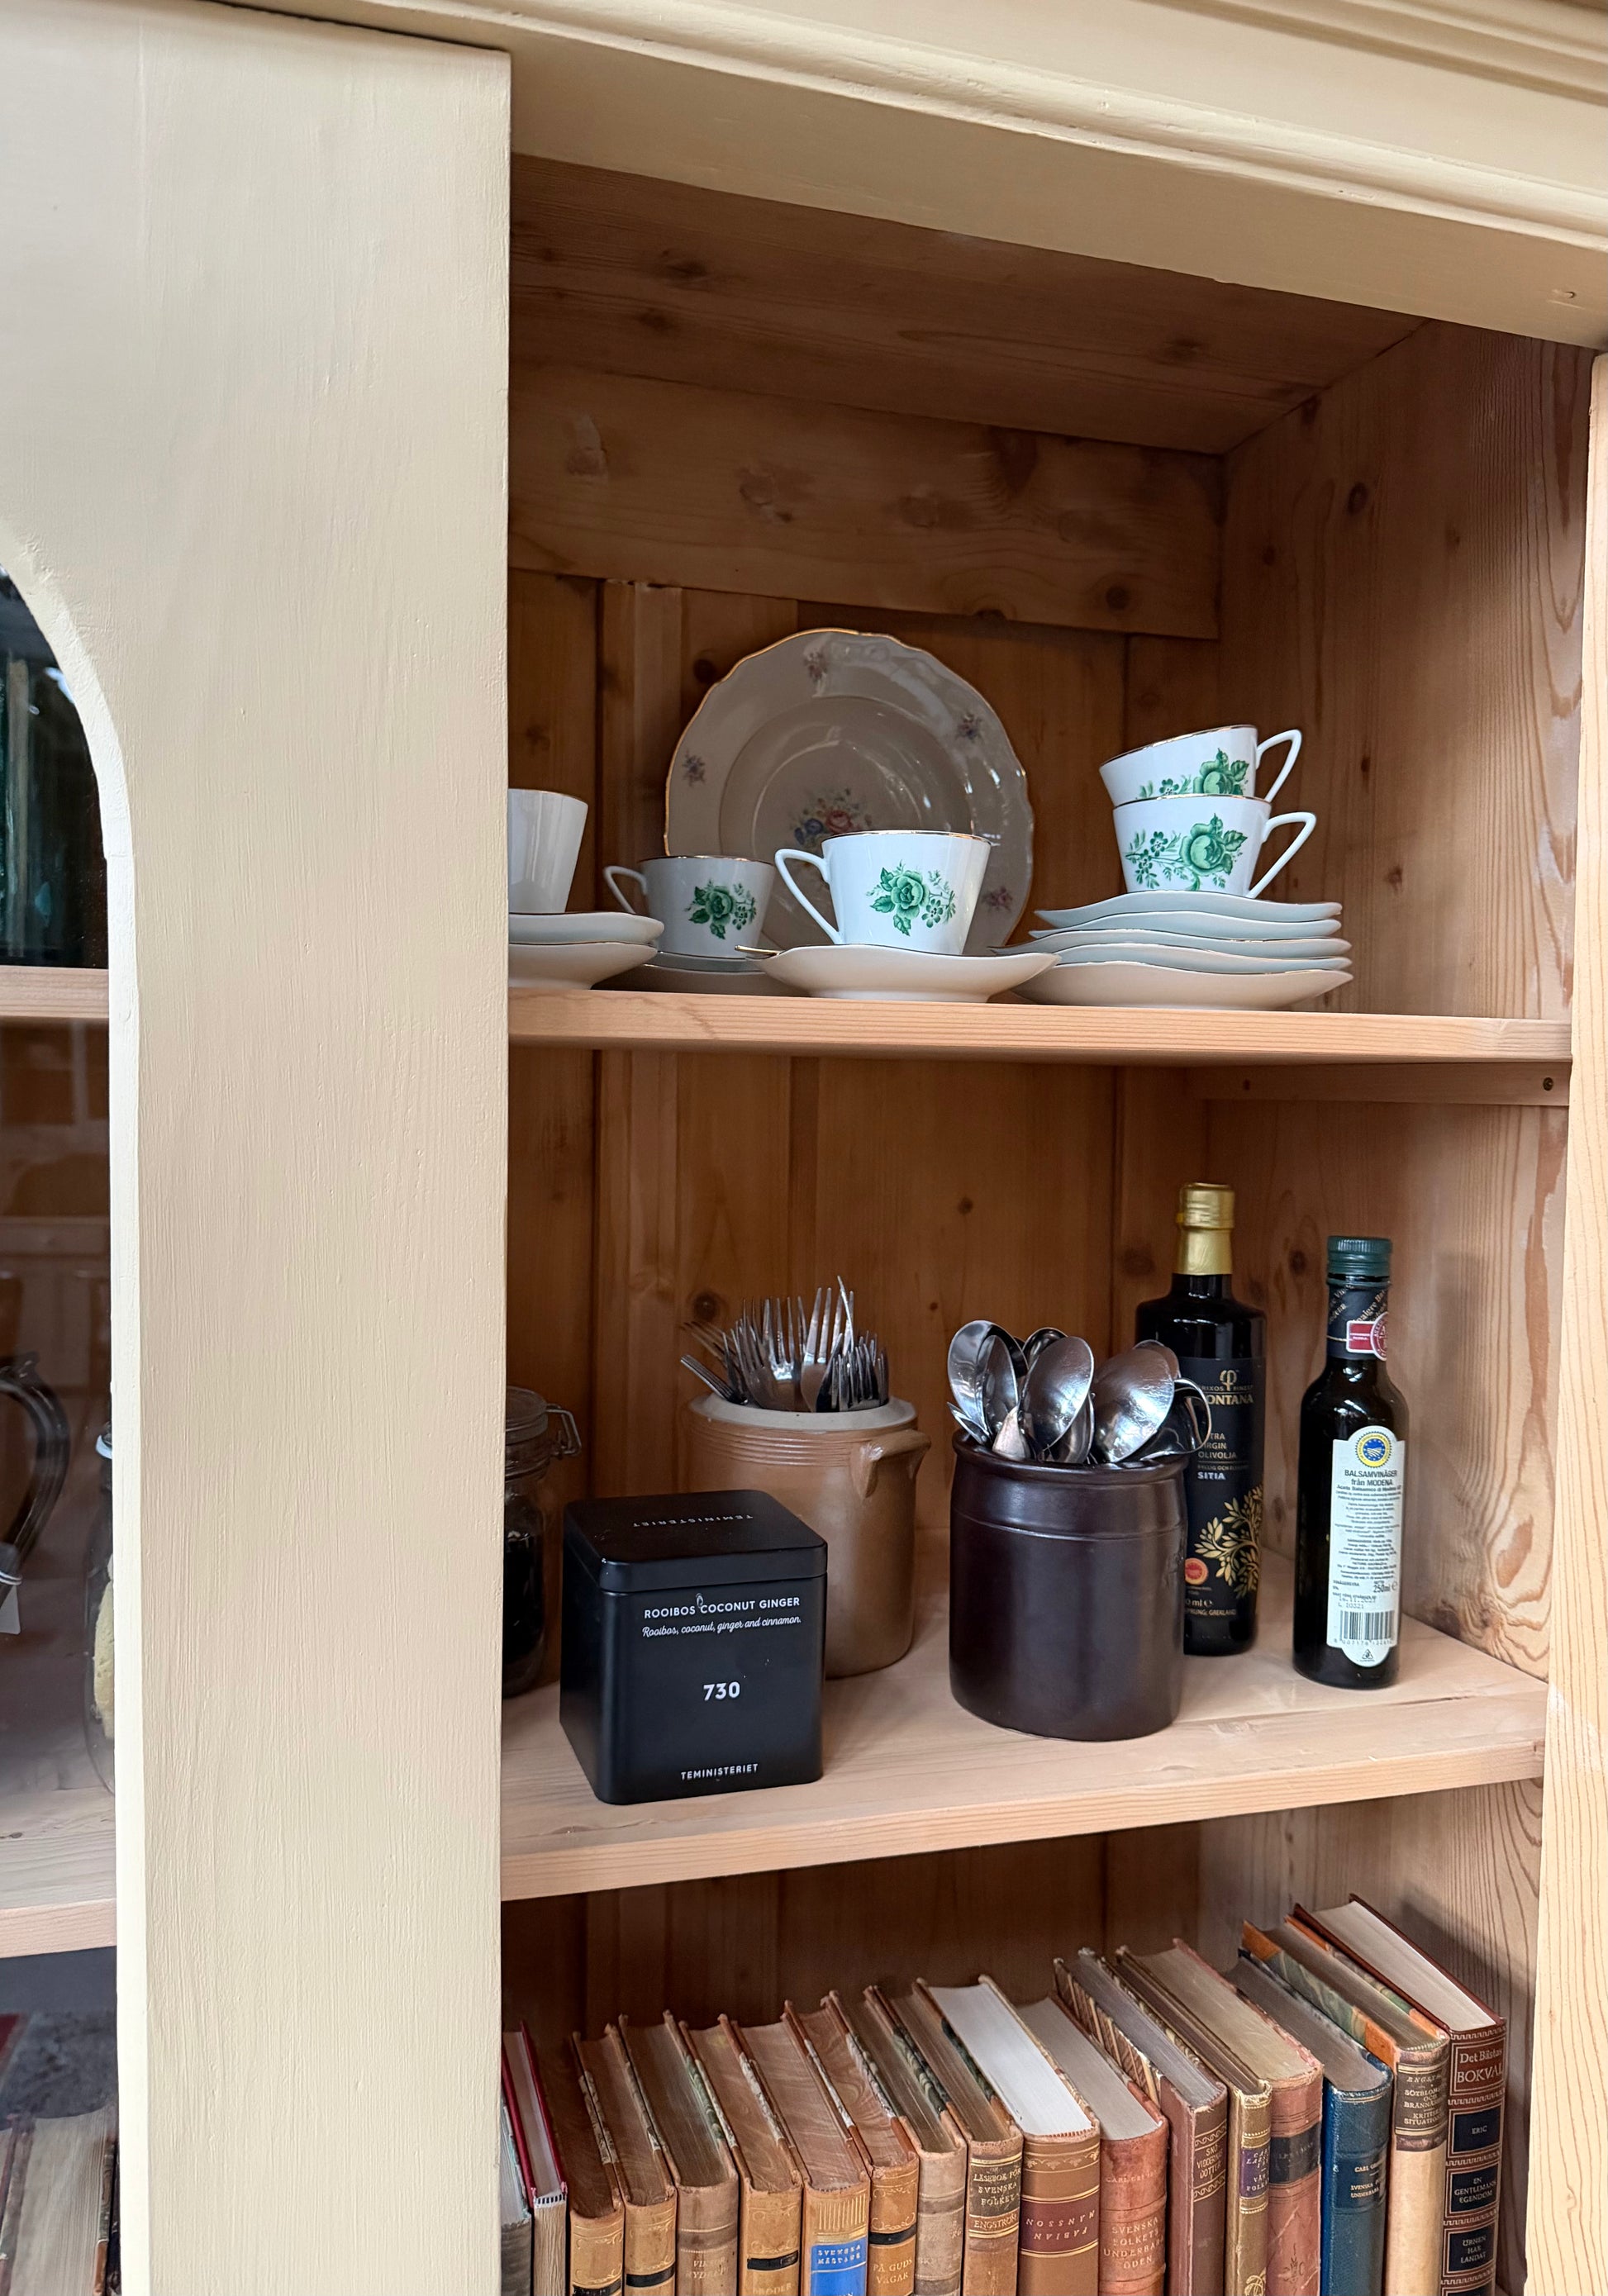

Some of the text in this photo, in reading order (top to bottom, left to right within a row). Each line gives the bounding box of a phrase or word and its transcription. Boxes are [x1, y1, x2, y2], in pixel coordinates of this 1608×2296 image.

[1206, 1394, 1254, 1405] ONTANA
[1197, 1471, 1226, 1480] SITIA
[633, 1514, 754, 1527] TEMINISTERIET
[644, 1596, 801, 1619] ROOIBOS COCONUT GINGER
[642, 1615, 802, 1638] Rooibos, coconut, ginger and cinnamon.
[703, 1681, 740, 1701] 730
[681, 1763, 759, 1780] TEMINISTERIET
[1459, 2053, 1478, 2064] Det
[1457, 2063, 1502, 2083] BOKVAL
[1472, 2126, 1487, 2134] ERIC
[978, 2182, 1017, 2194] SVENSKA
[1454, 2181, 1496, 2196] GENTLEMANS
[981, 2194, 1015, 2205] FOLKET
[1459, 2190, 1493, 2203] EGENDOM
[1112, 2217, 1158, 2234] SVENSKA
[1034, 2227, 1087, 2241] FABIAN
[1113, 2227, 1158, 2246] FOLKETS
[1463, 2235, 1487, 2246] ÖRNEN
[818, 2245, 861, 2256] SVENSKA
[1468, 2246, 1482, 2254] HAR
[1460, 2251, 1487, 2263] LANDAT
[873, 2263, 885, 2273] PÅ
[888, 2259, 912, 2272] GUDS
